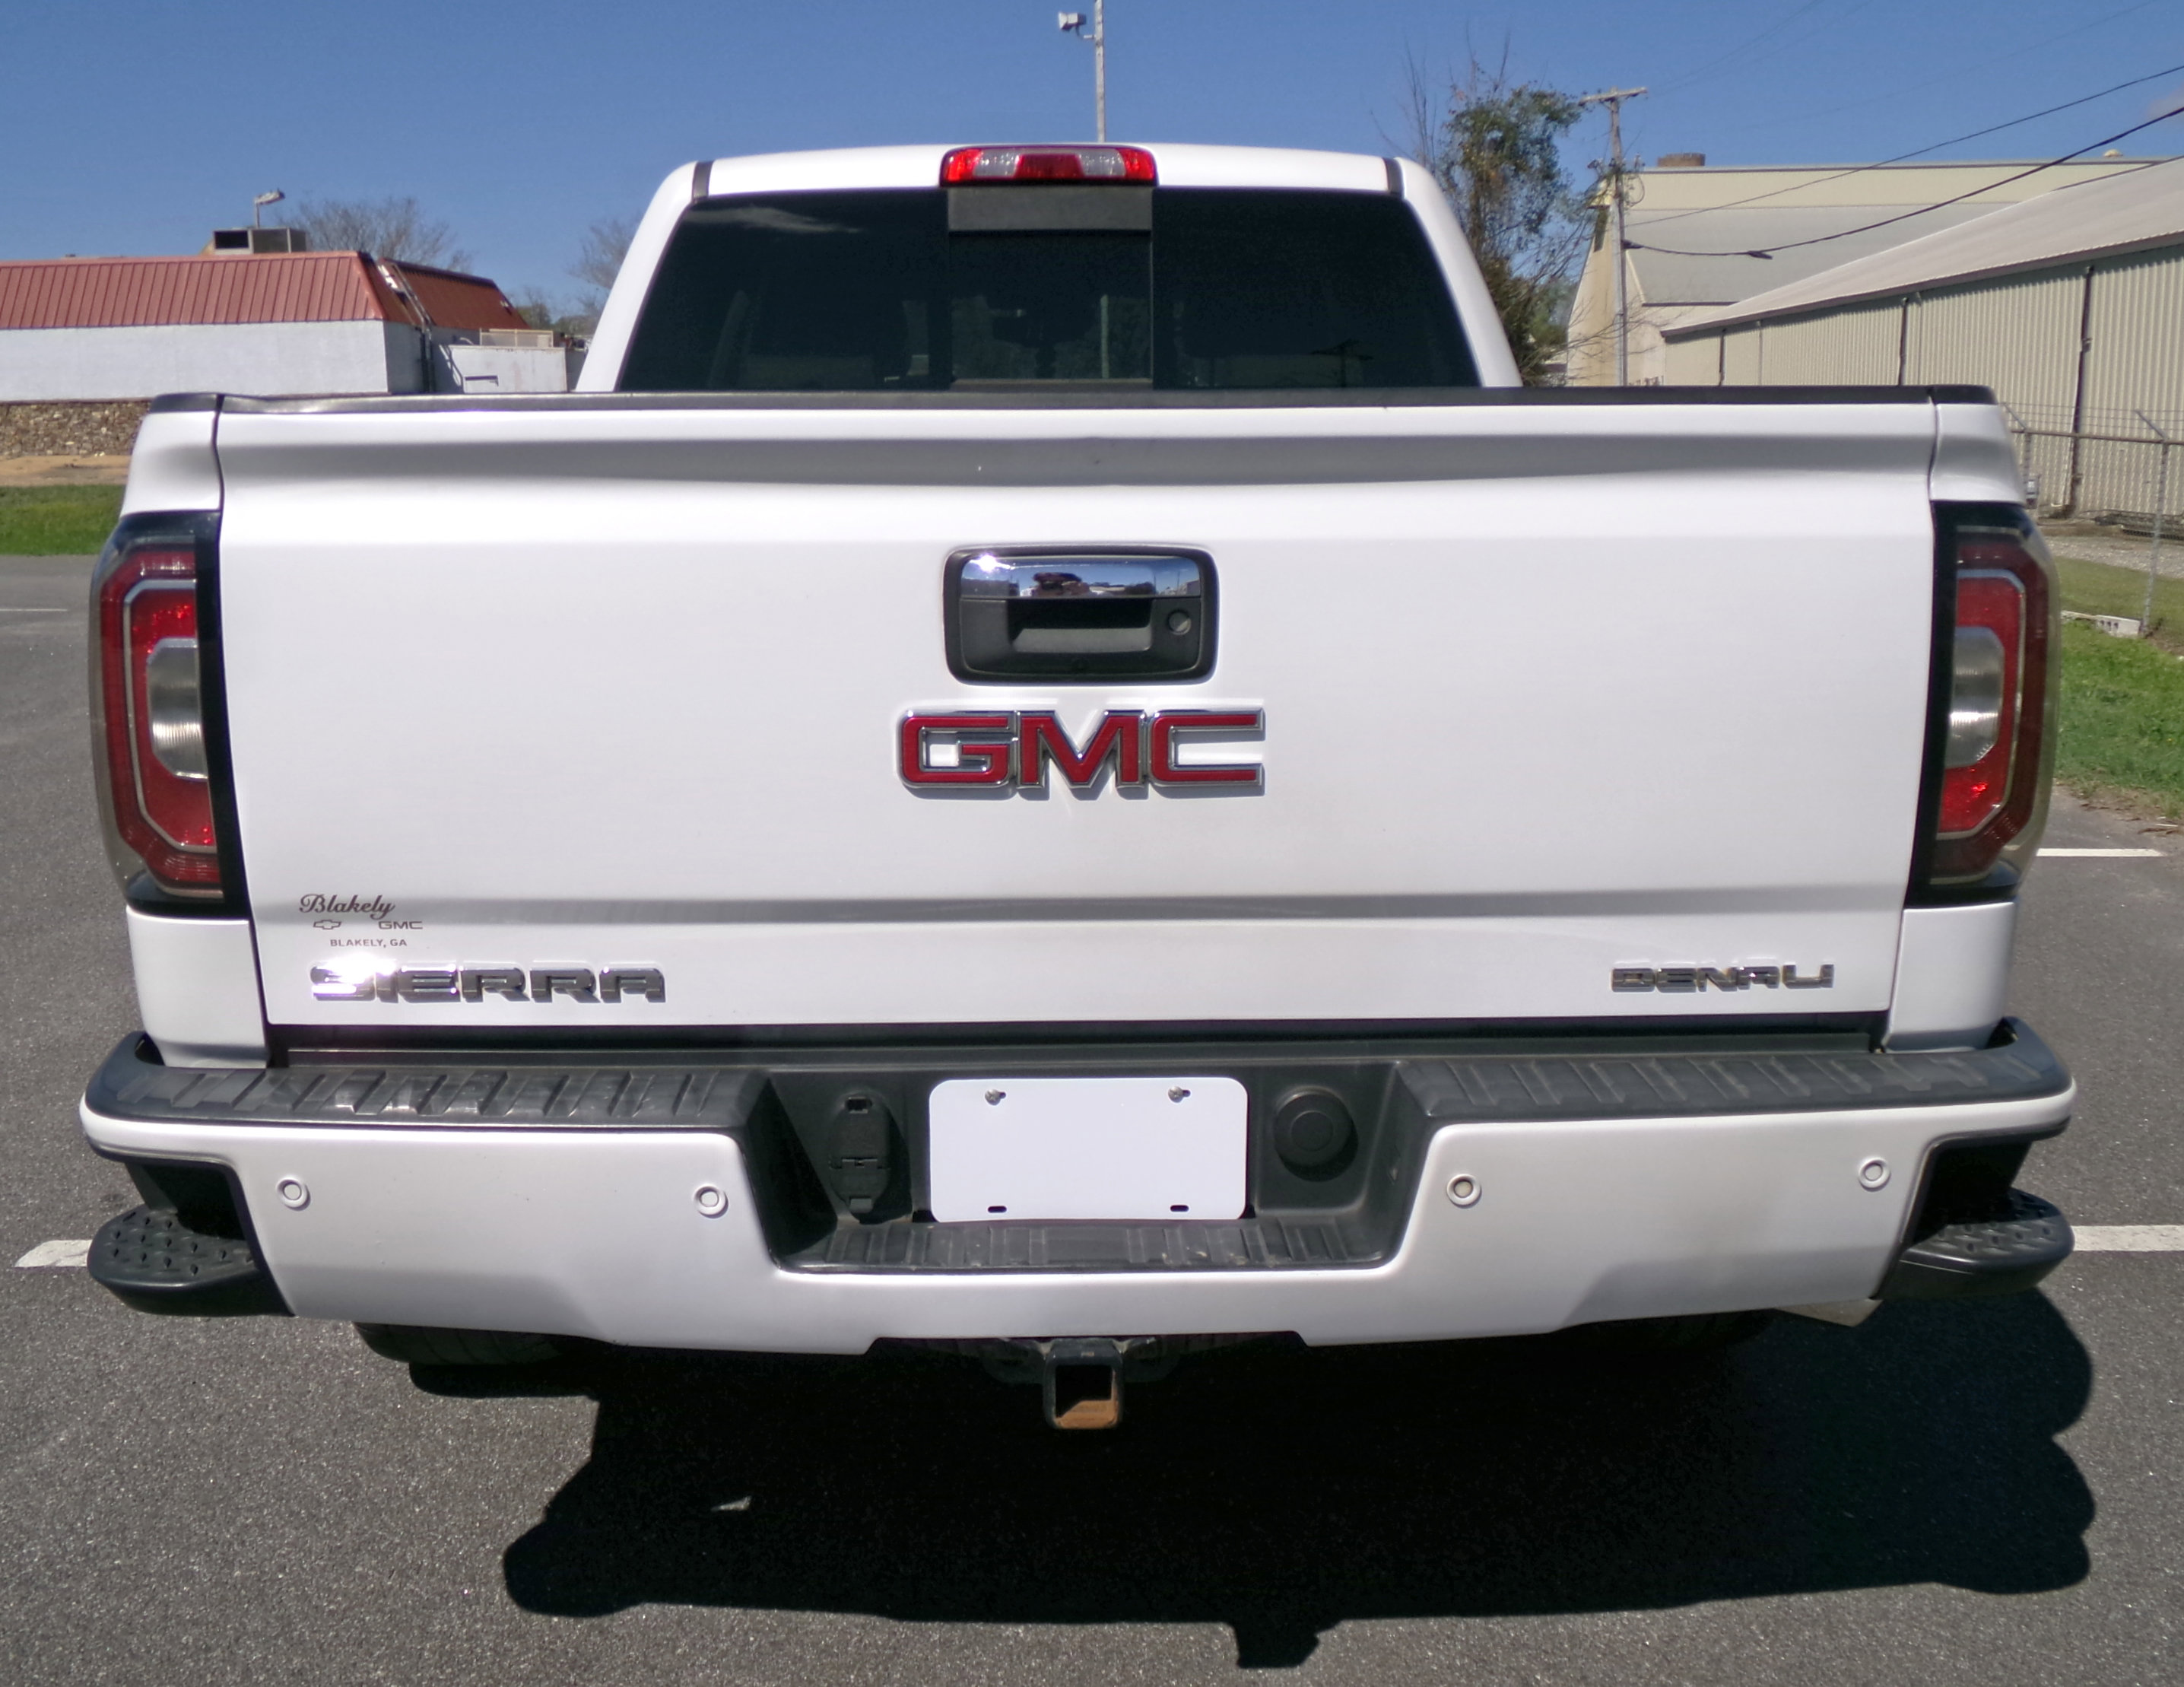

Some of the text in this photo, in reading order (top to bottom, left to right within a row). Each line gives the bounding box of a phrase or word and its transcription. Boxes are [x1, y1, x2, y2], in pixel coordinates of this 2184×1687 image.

[900, 709, 1264, 791] GMC
[299, 893, 395, 920] Blakely
[378, 921, 423, 929] GMC
[330, 939, 407, 948] BLAKELY, GA
[310, 961, 665, 1002] SIERRA
